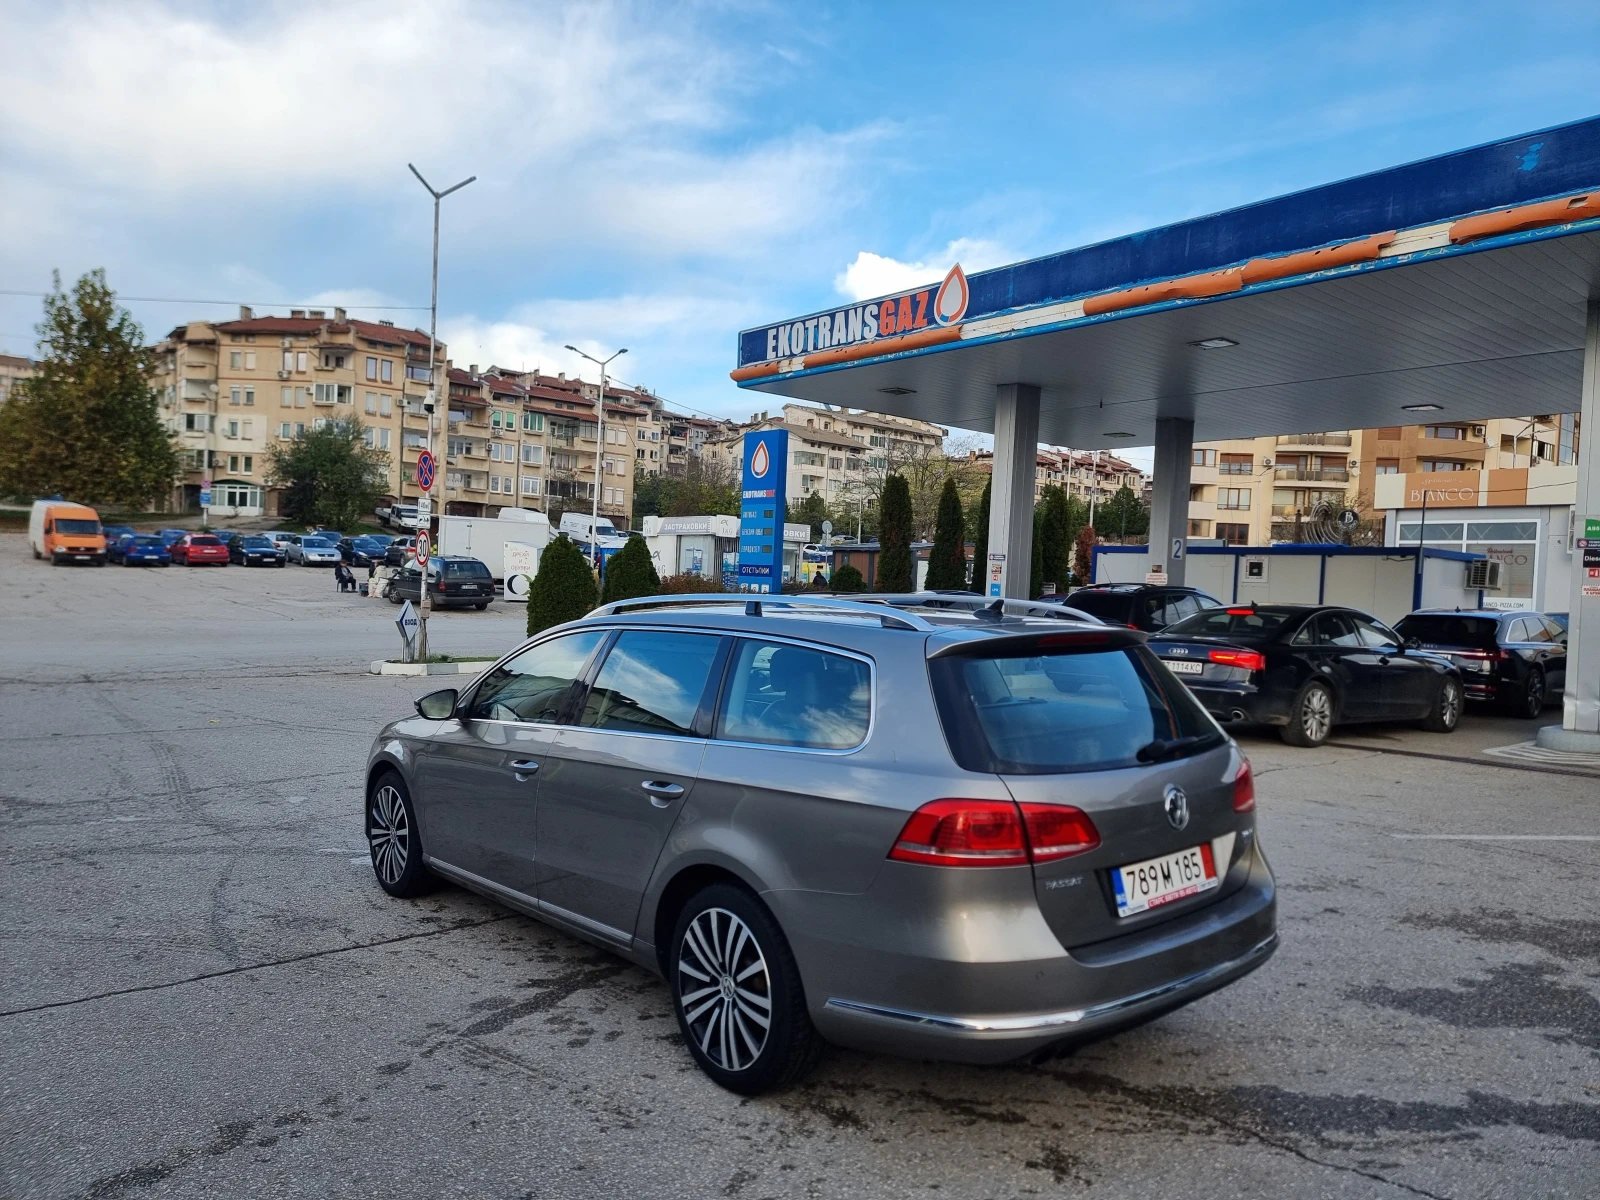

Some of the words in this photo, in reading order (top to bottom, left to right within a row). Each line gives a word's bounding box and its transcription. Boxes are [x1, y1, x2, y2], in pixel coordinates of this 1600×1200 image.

[766, 290, 929, 360] EKOTRANSGAZ
[1411, 487, 1474, 502] BIANCO
[664, 522, 708, 531] ЗАСТРАХОВКИ
[783, 529, 806, 538] ОВКИ
[419, 539, 427, 557] 30
[1173, 540, 1182, 558] 2
[742, 566, 770, 575] ОТСТЪПКИ
